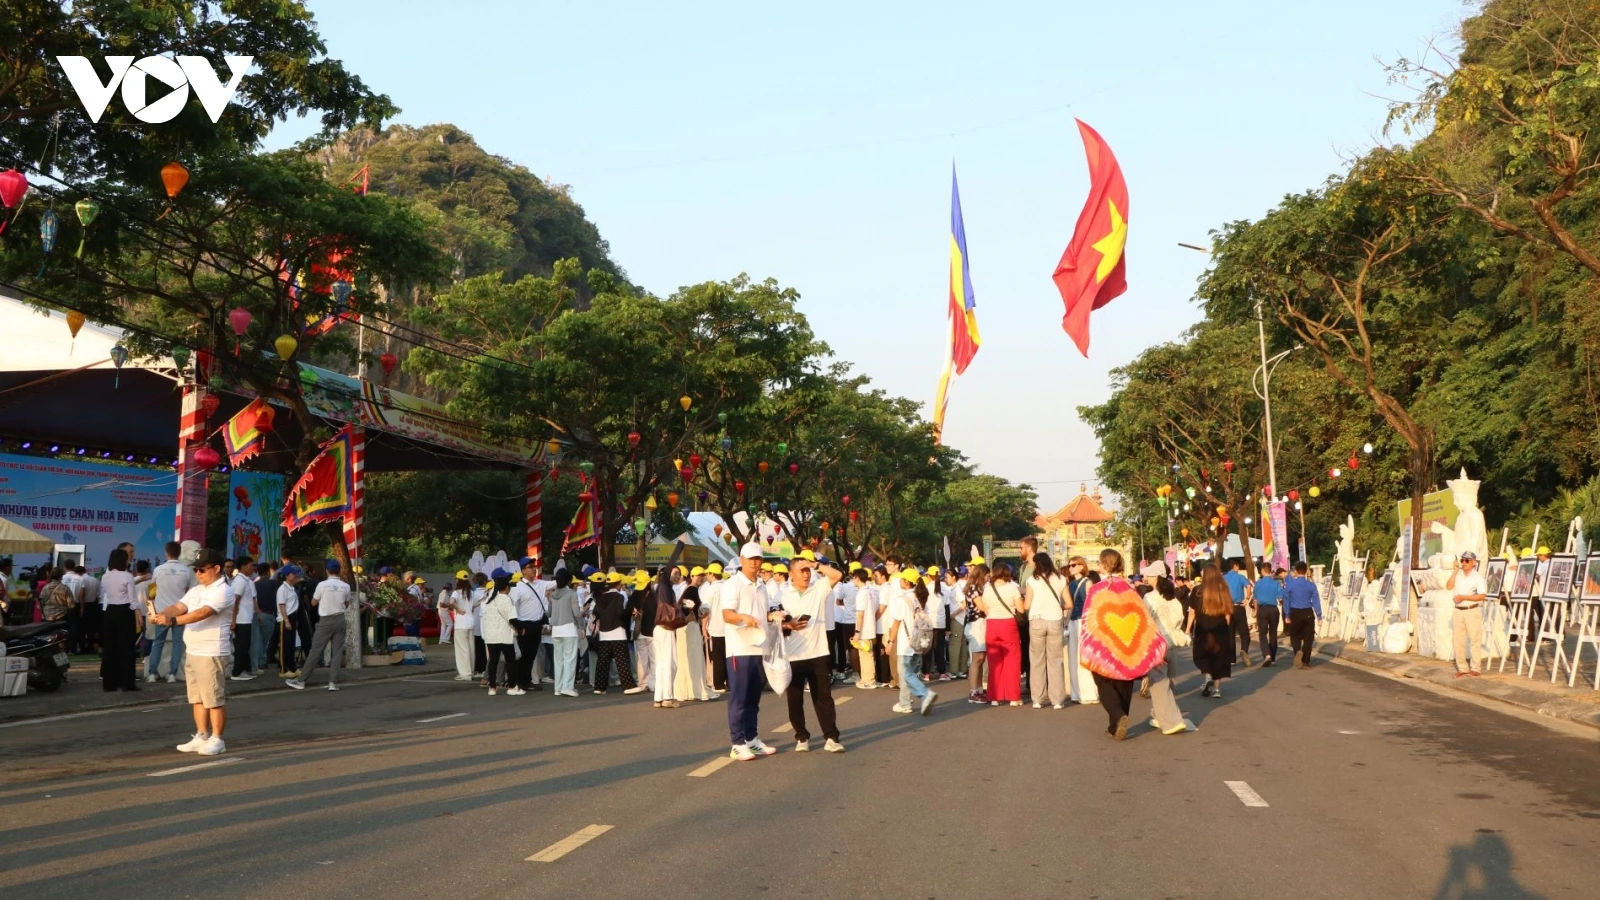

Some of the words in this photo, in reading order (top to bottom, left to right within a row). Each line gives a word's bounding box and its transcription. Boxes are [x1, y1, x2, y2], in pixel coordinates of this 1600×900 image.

[33, 522, 70, 531] WALKING
[73, 524, 87, 532] FOR
[91, 525, 113, 533] PEACE
